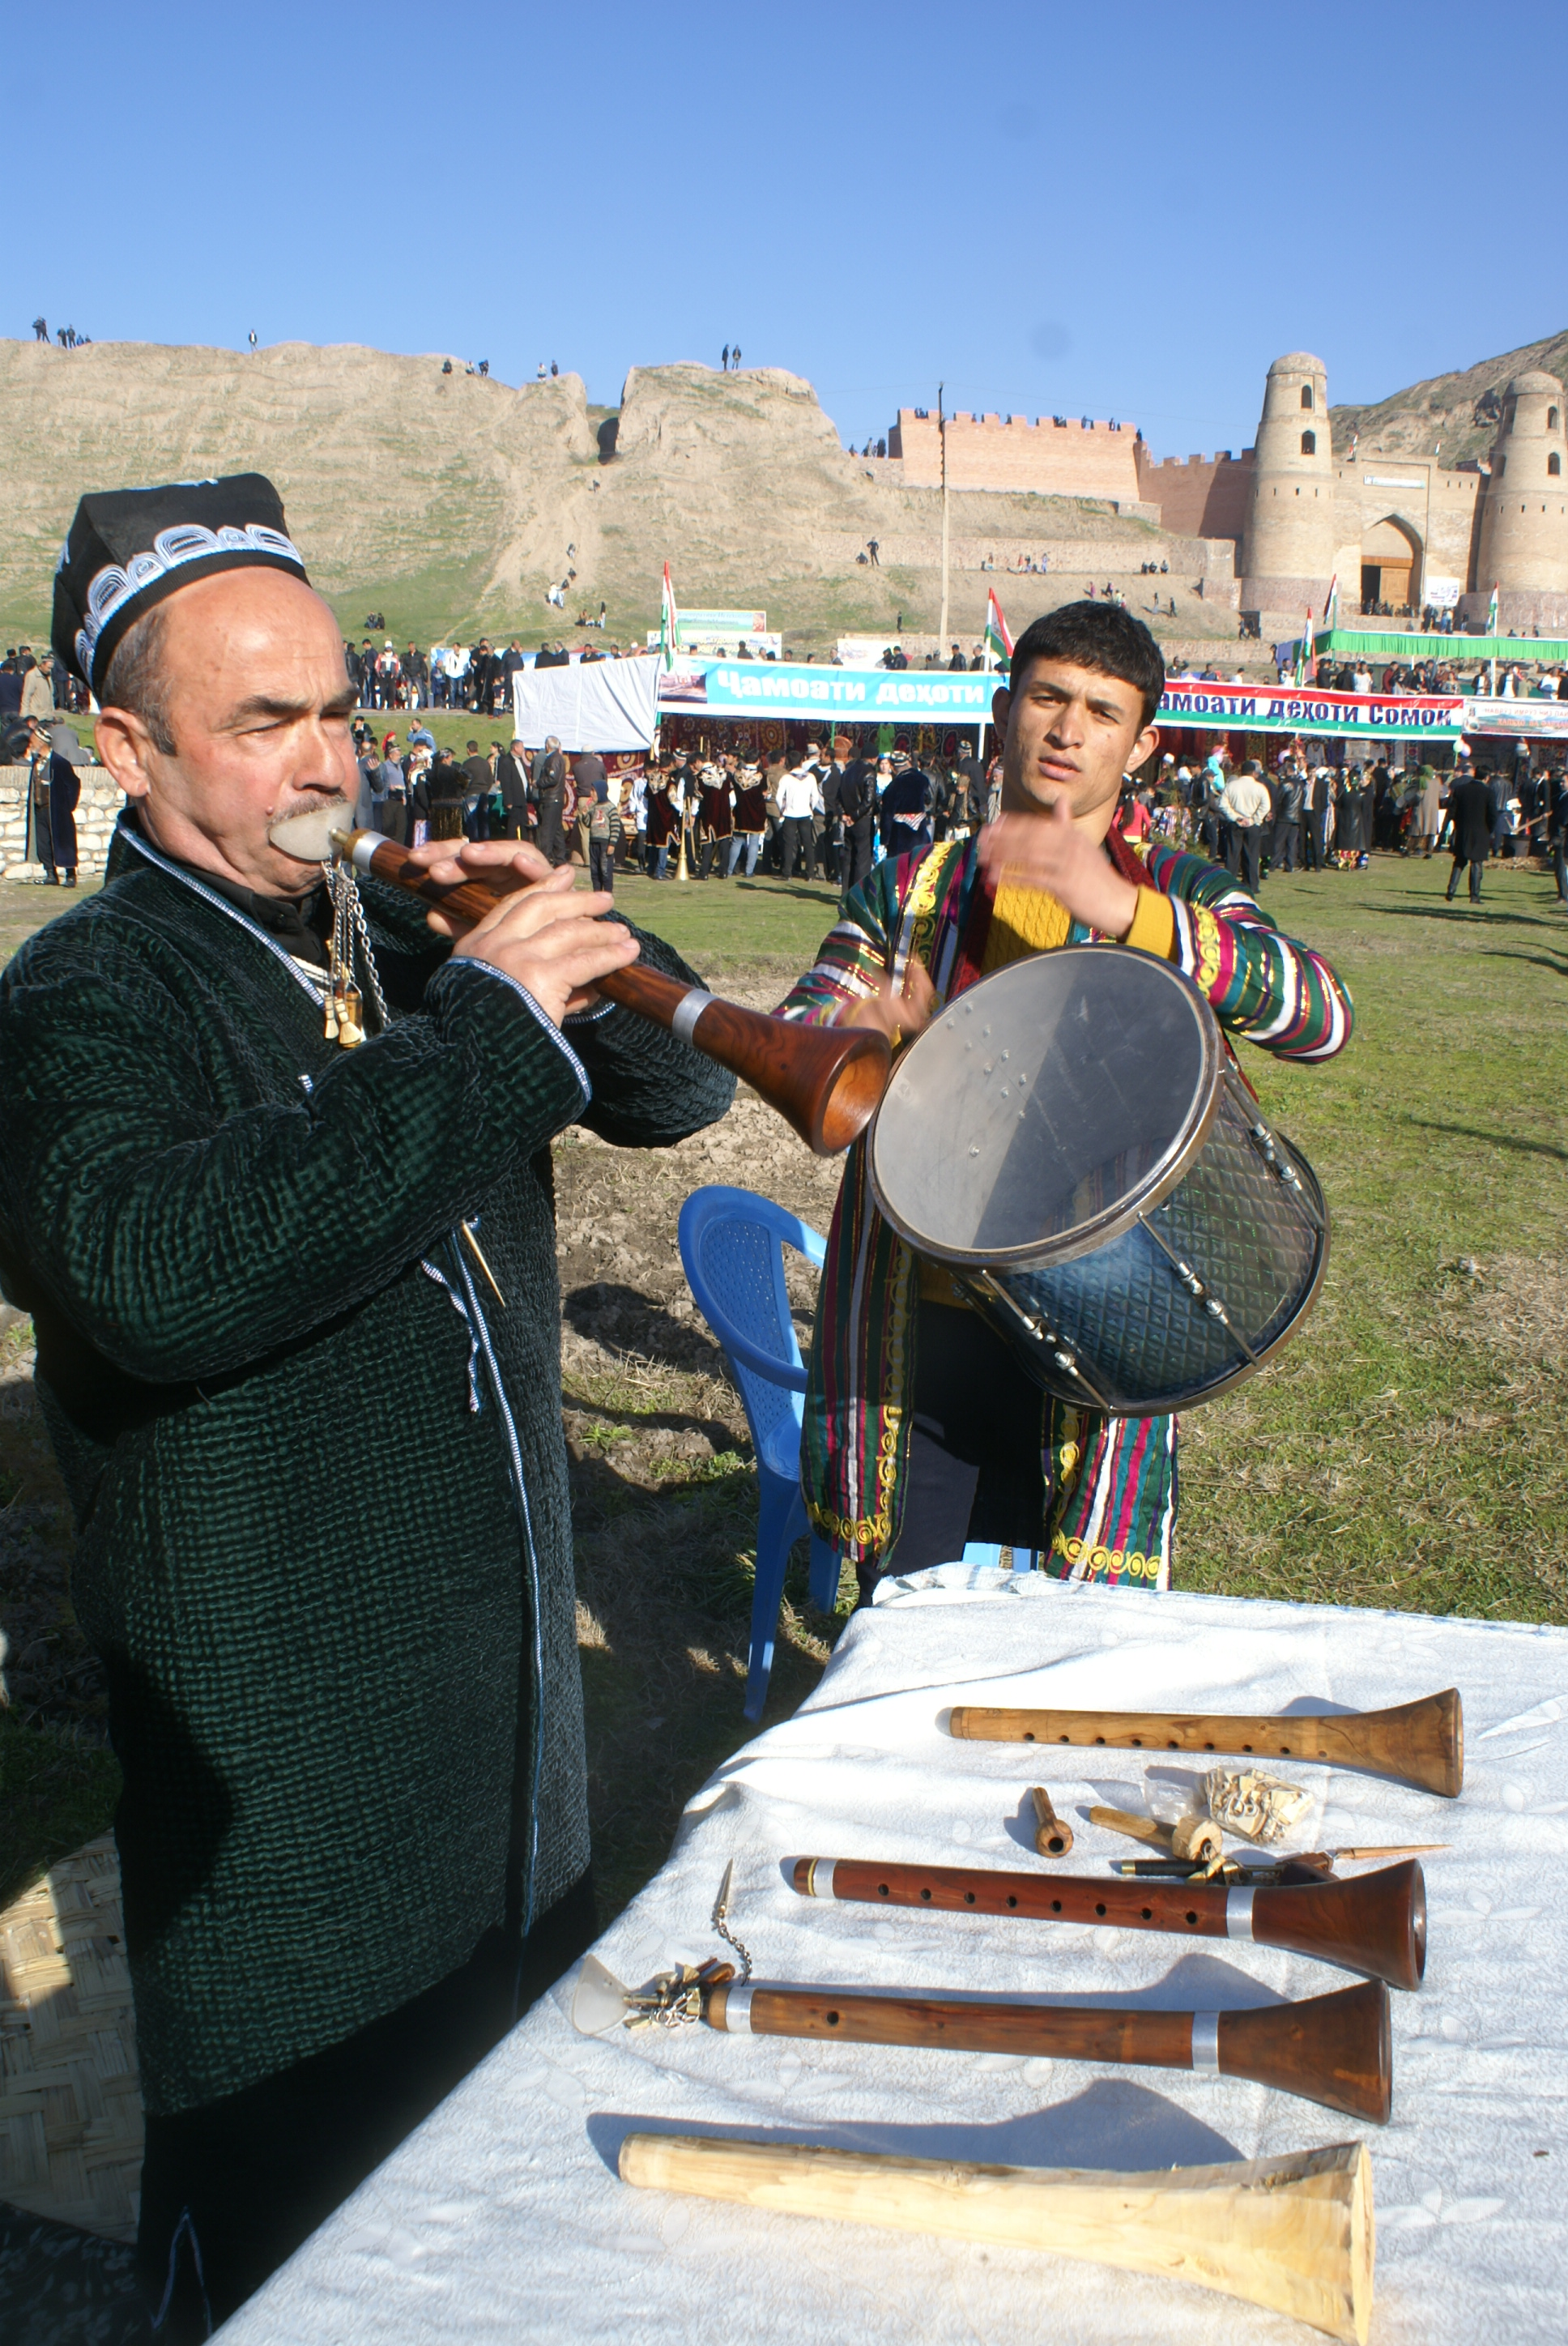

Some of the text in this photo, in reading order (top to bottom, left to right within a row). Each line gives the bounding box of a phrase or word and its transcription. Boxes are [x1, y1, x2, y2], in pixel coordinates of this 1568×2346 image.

[718, 670, 984, 706] Ҷамоати деҳоти
[1159, 693, 1255, 716] амоати
[1267, 700, 1358, 723] деҳоти
